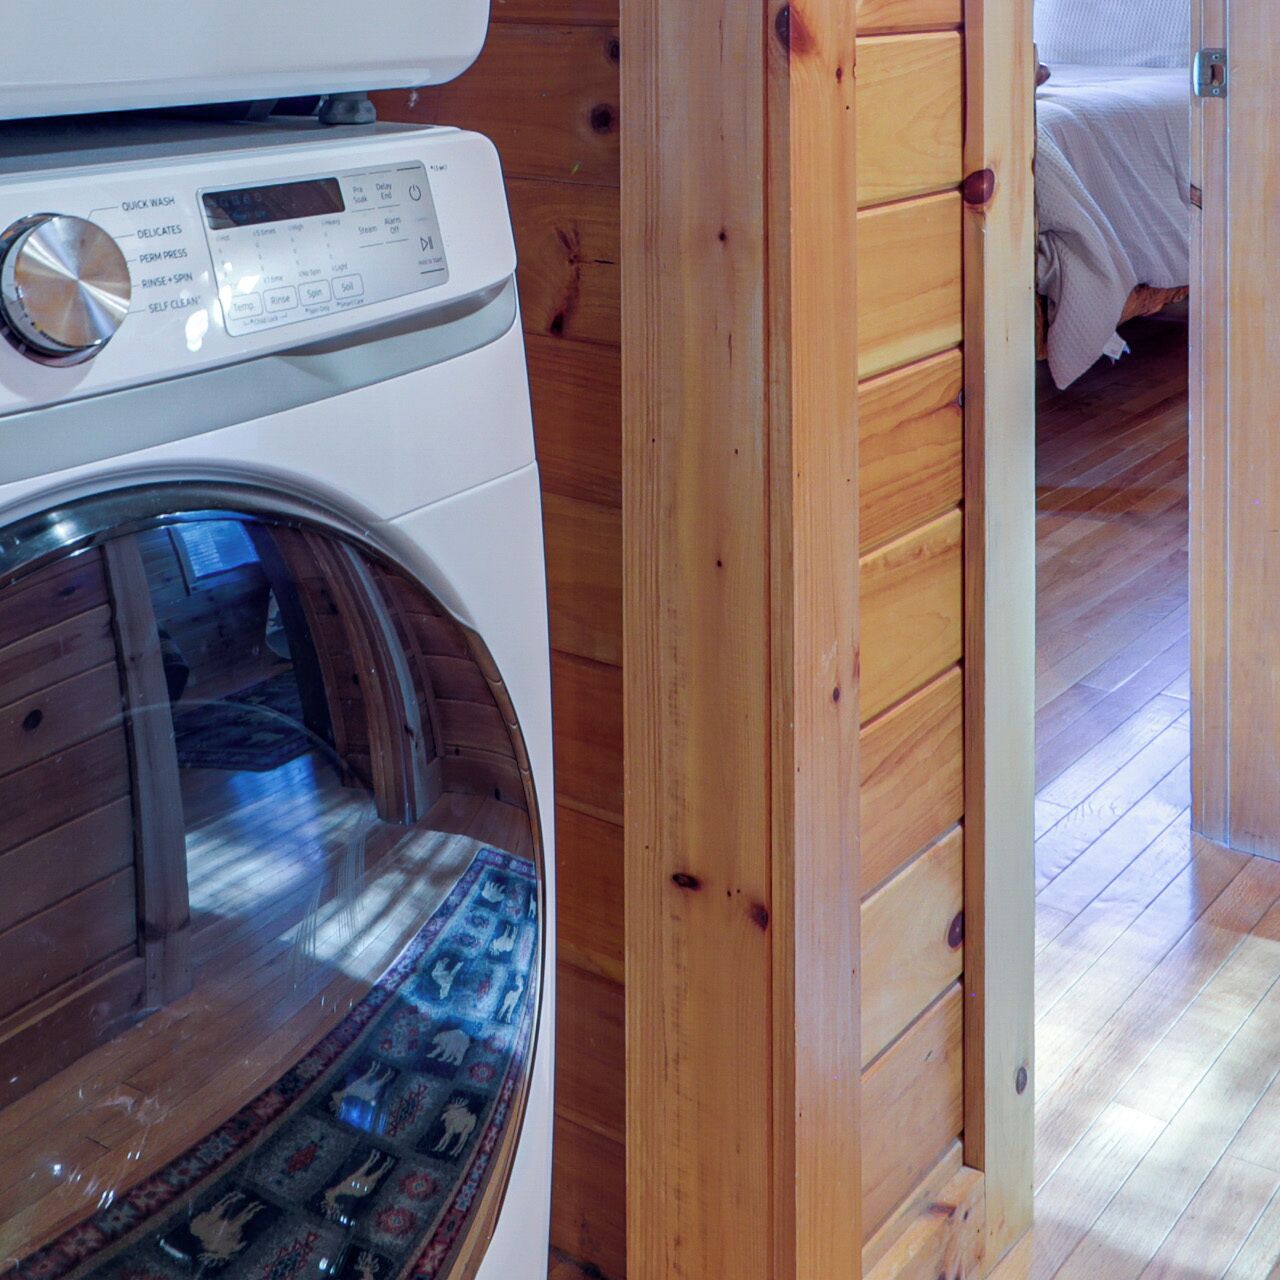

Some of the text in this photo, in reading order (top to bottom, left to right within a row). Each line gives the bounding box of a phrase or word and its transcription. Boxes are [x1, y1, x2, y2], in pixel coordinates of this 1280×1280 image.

[376, 183, 392, 191] Delay
[381, 192, 392, 200] End
[121, 196, 175, 212] QUICK WASH
[137, 225, 182, 239] DELICATES
[358, 225, 377, 234] Steam
[139, 248, 188, 264] PERM PRESS
[341, 282, 354, 292] Soil
[306, 289, 322, 299] Spin
[271, 295, 290, 304] Rinse
[148, 301, 168, 313] SELF
